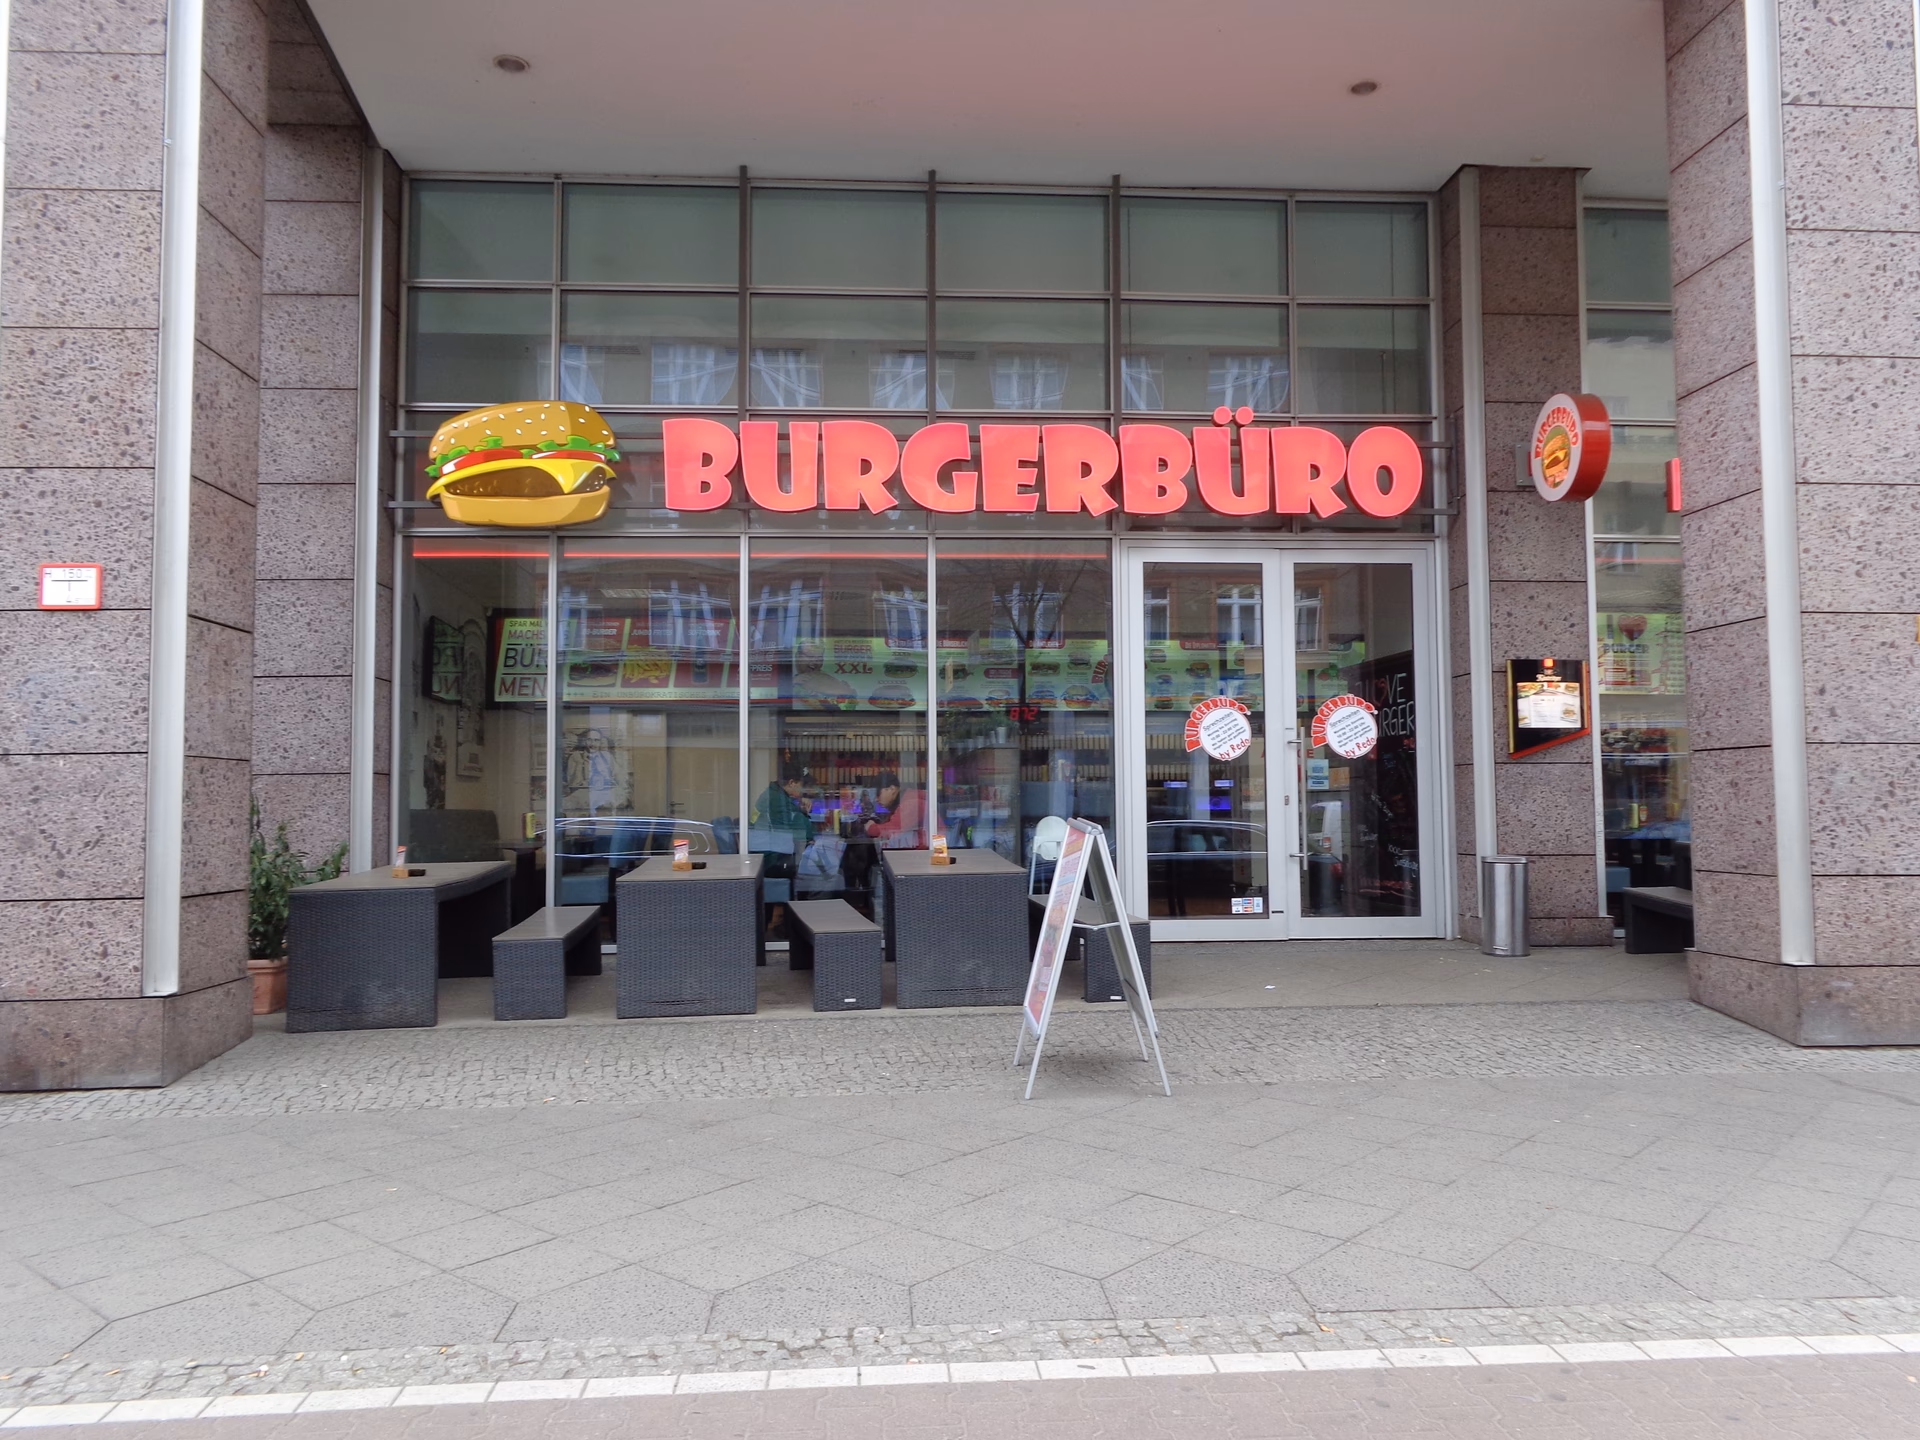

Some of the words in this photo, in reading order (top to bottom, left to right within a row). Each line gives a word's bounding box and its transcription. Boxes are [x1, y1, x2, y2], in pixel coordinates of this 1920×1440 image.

[1534, 406, 1579, 459] BURGERBÜRO
[662, 406, 1423, 518] BURGERBÜRO
[835, 661, 874, 674] XXL
[1184, 696, 1248, 752] BURGERBÜRO
[1311, 694, 1375, 748] BURGERBÜRO
[1344, 747, 1357, 757] by
[1355, 736, 1376, 752] Redo
[1218, 749, 1231, 760] by
[1230, 738, 1250, 753] Redo
